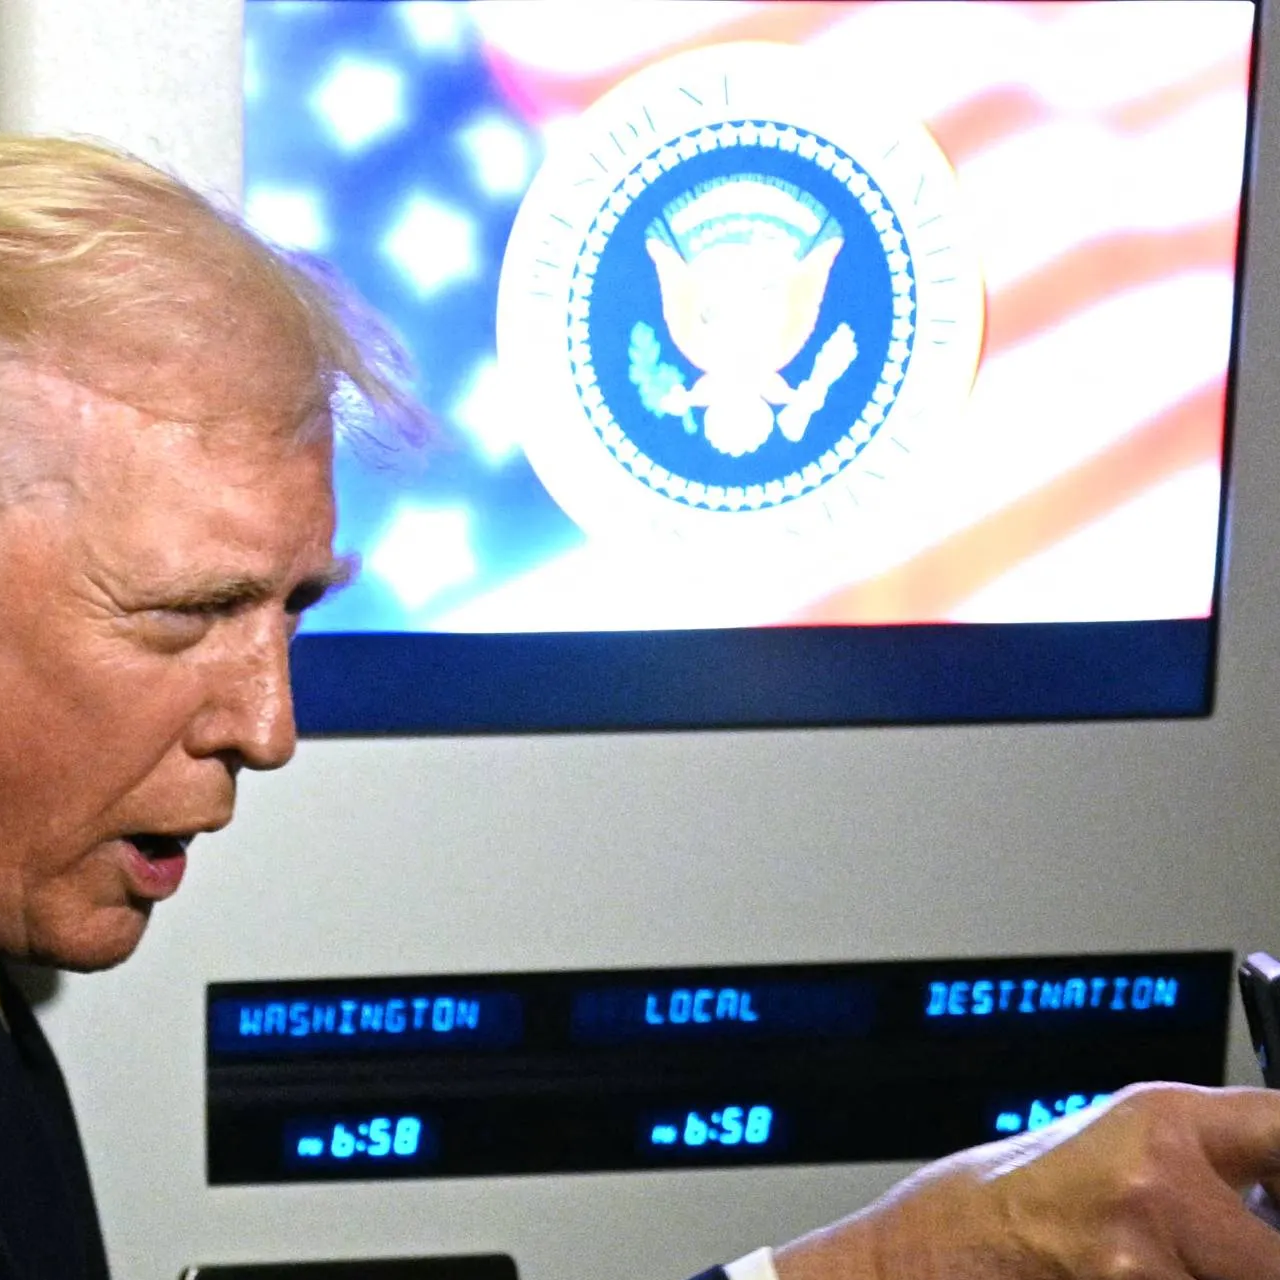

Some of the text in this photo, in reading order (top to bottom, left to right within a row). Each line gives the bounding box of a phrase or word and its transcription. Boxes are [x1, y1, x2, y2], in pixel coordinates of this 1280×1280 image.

[645, 987, 759, 1025] LOCAL
[926, 976, 1179, 1016] DESTINATION
[239, 997, 480, 1037] WASHINGTON
